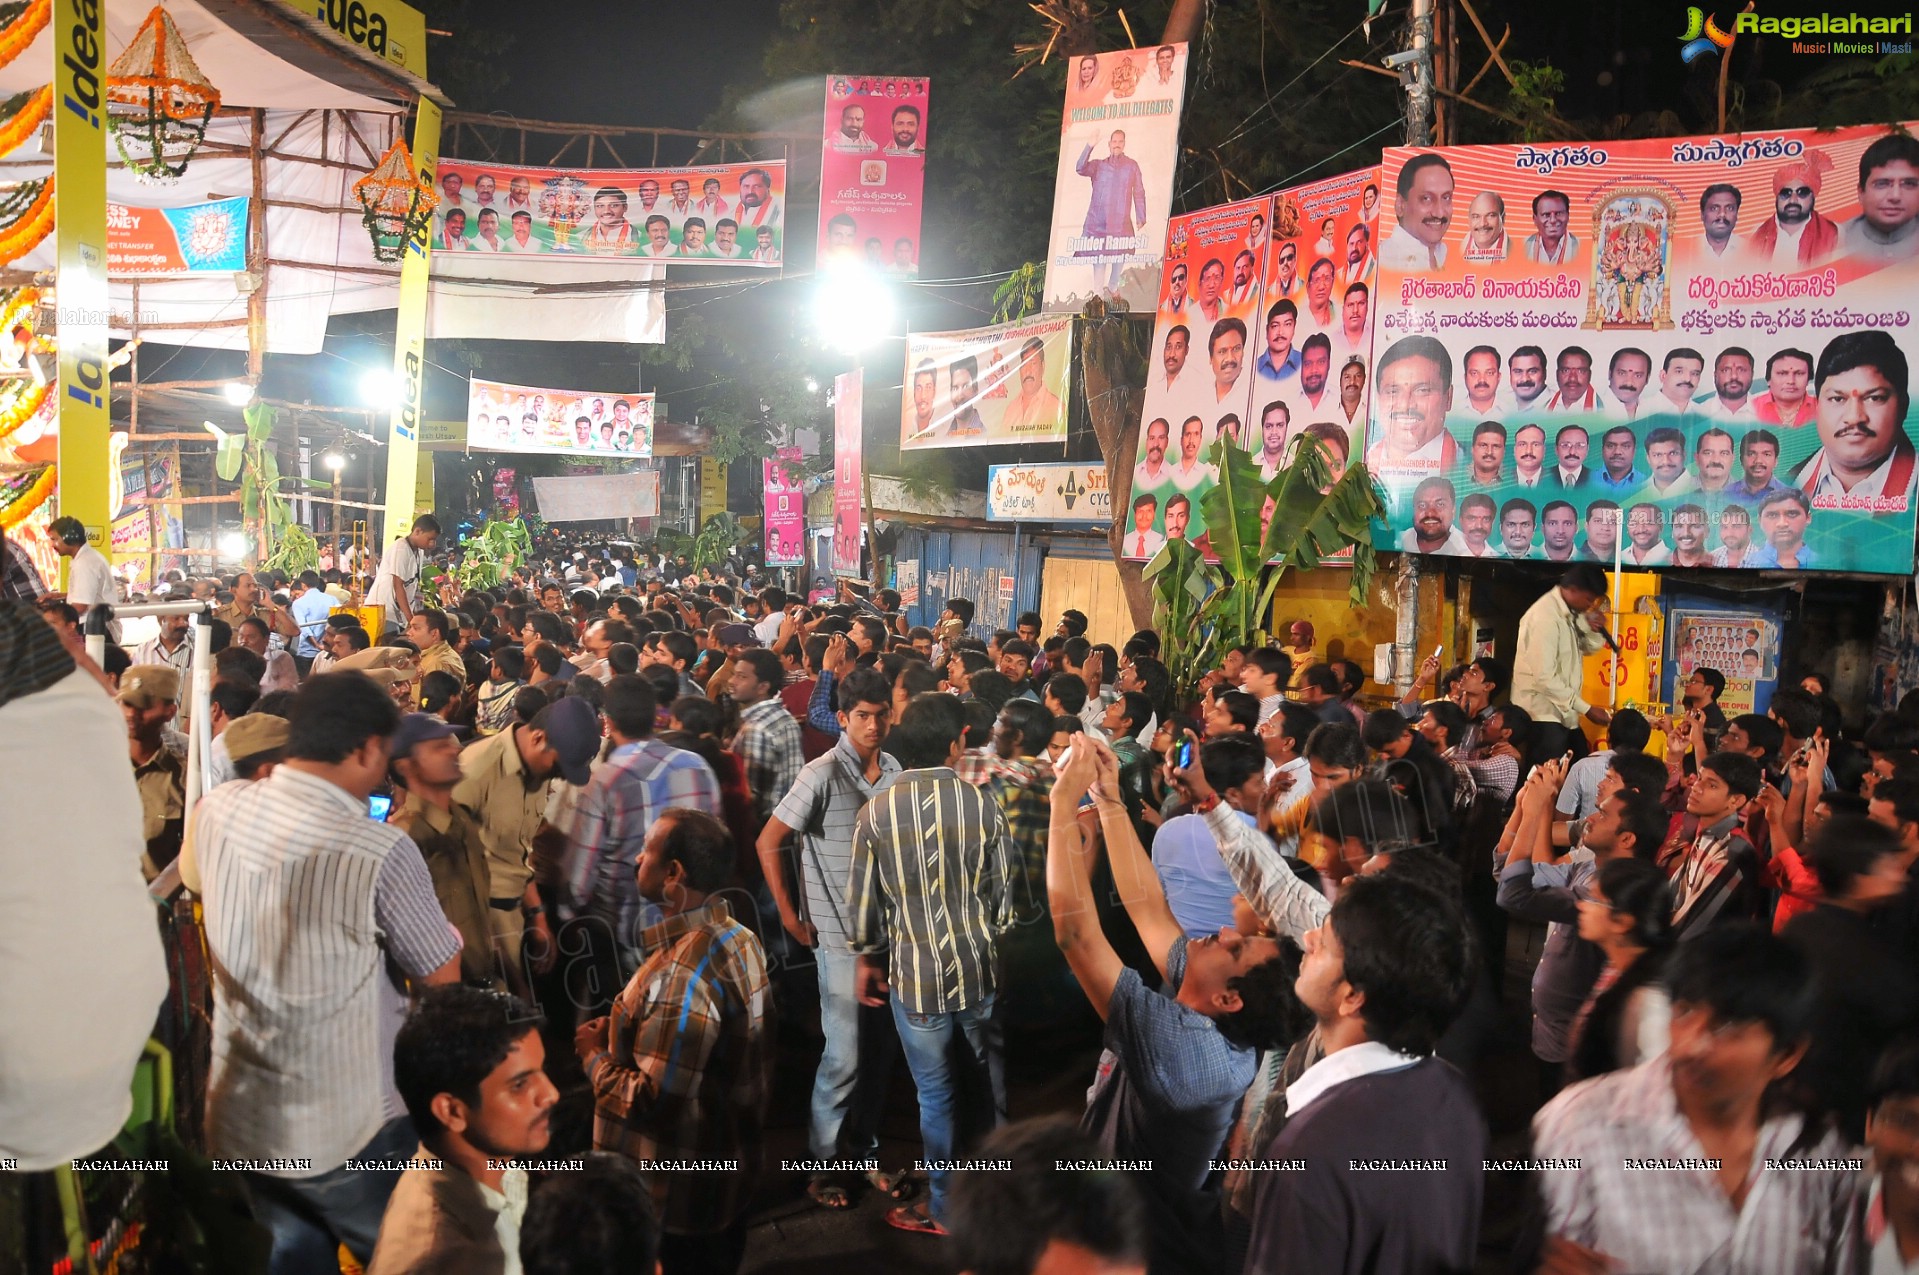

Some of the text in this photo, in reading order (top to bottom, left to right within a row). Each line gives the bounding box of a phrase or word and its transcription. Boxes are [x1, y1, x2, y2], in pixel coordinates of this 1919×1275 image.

[1072, 98, 1174, 122] WELCOME TO ALL DELEGATES
[1516, 146, 1607, 174] స్వాగతం
[1673, 138, 1803, 167] సుస్వాగతం
[1067, 235, 1149, 252] Builder Ramesh
[1402, 269, 1837, 309] ఖైరతాబాద్ వినాయకుడిని దర్శించుకోవడానికి
[1440, 310, 1519, 329] నాయకులకు
[1522, 310, 1578, 329] మరియు
[1680, 309, 1747, 335] భక్తులకు
[1750, 308, 1807, 335] స్వాగత
[1811, 307, 1911, 329] సుమాంజలి
